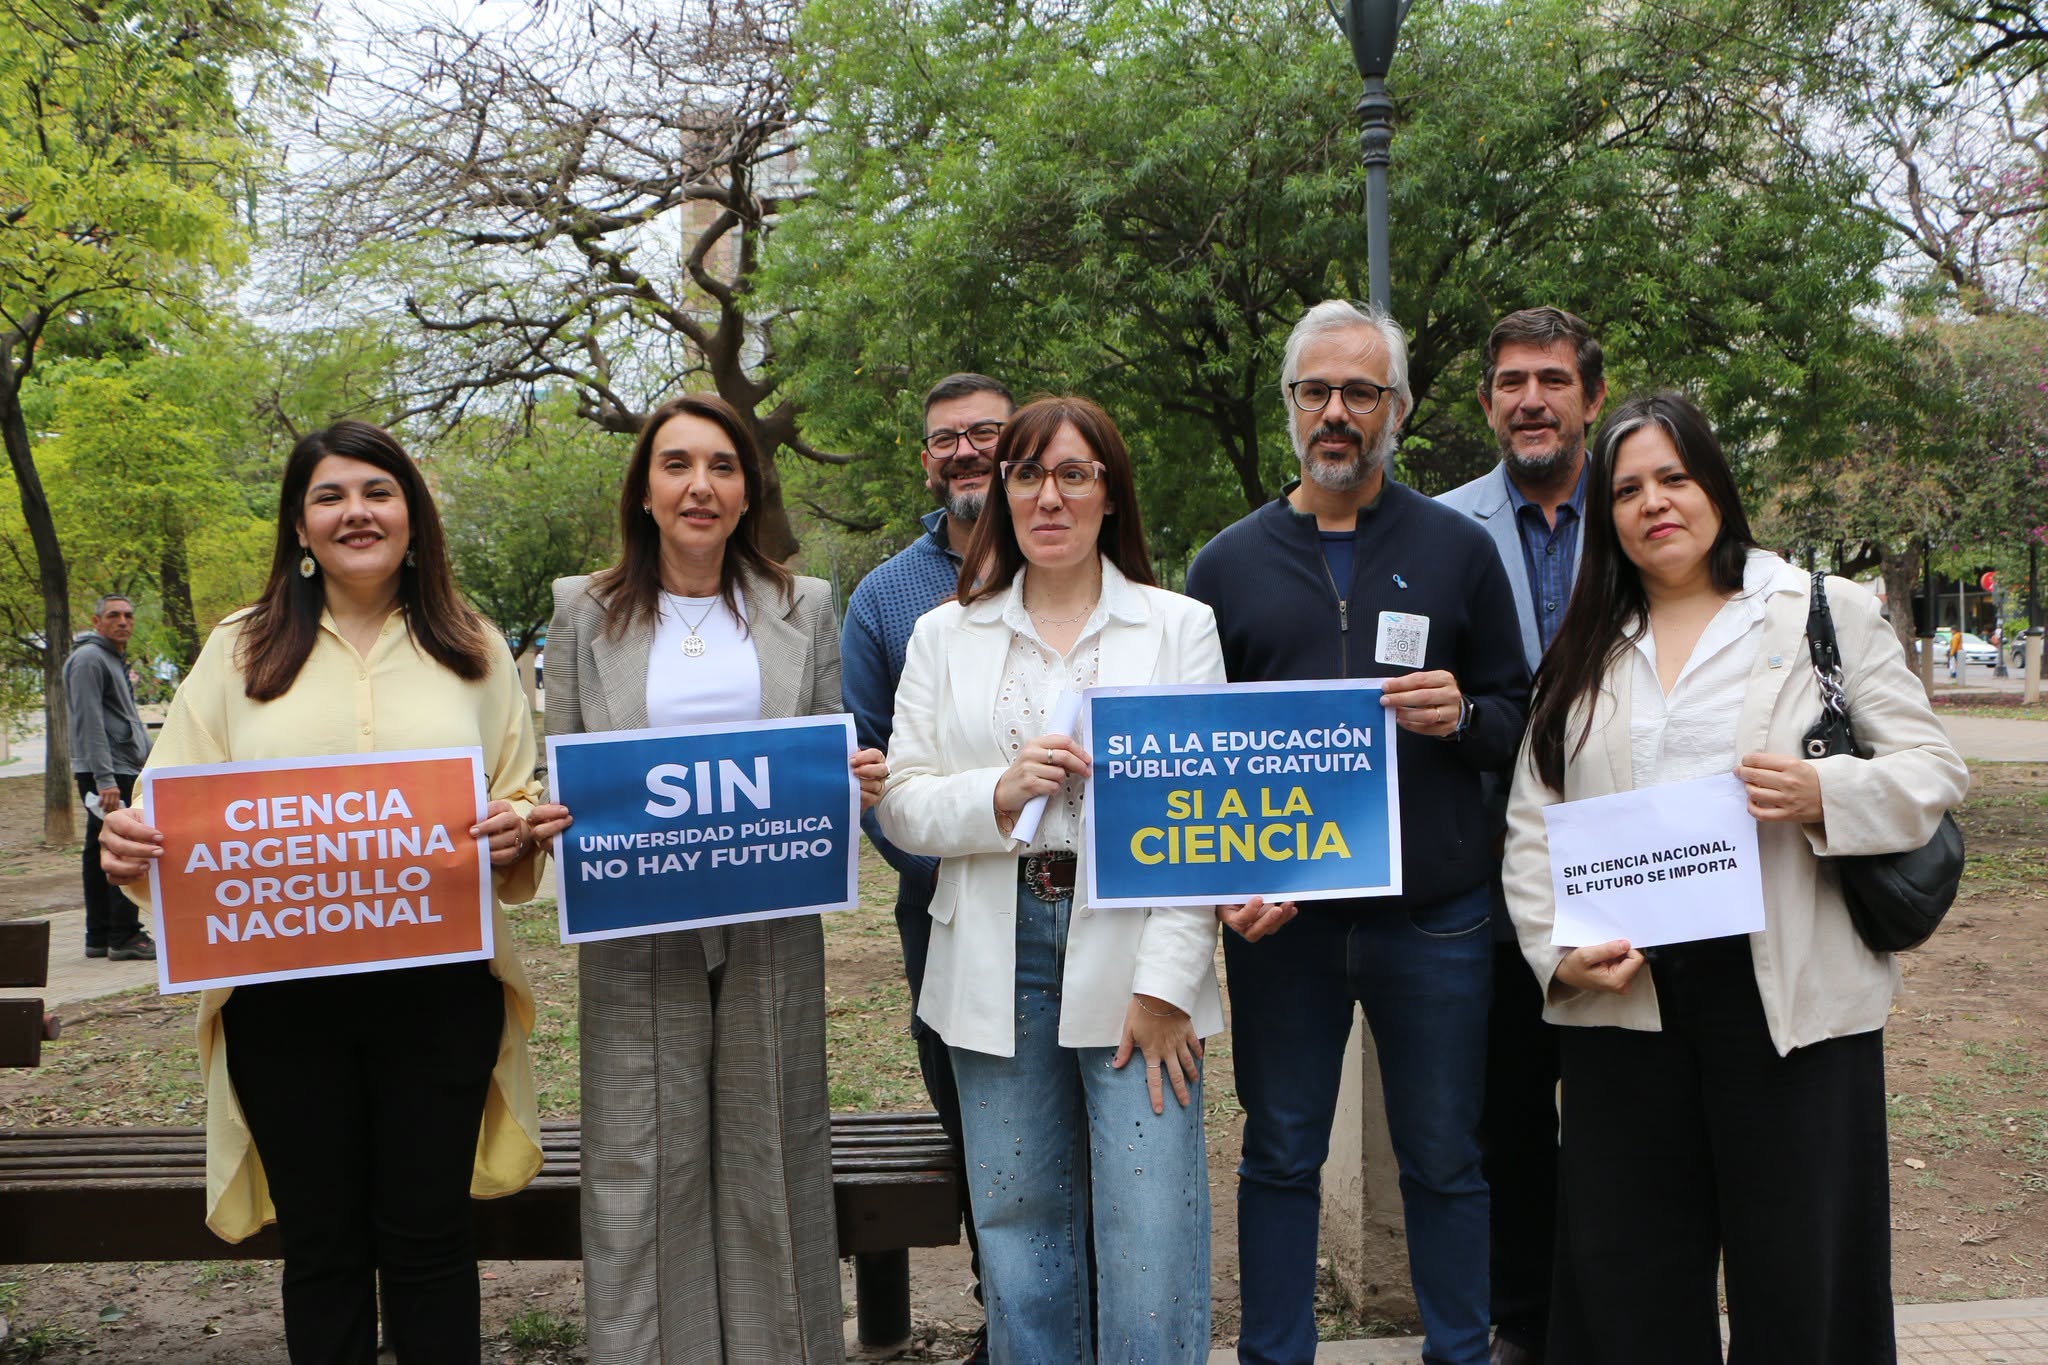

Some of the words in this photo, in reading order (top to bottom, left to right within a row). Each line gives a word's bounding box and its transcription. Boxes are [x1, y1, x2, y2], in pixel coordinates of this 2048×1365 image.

[1107, 735, 1133, 755] SI
[1140, 734, 1161, 754] A
[1169, 732, 1203, 753] LA
[1212, 723, 1372, 753] EDUCACIÓN
[1108, 755, 1217, 779] PÚBLICA
[1224, 757, 1241, 775] Y
[1247, 753, 1372, 774] GRATUITA
[645, 756, 771, 818] SIN
[1166, 789, 1203, 820] SI
[1216, 788, 1248, 818] A
[1261, 786, 1313, 817] LA
[224, 788, 412, 832] CIENCIA
[184, 825, 455, 873] ARGENTINA
[579, 825, 734, 852] UNIVERSIDAD
[741, 815, 833, 838] PÚBLICA
[1130, 821, 1351, 865] CIENCIA
[581, 859, 628, 882] NO
[638, 851, 702, 876] HAY
[712, 838, 832, 868] FUTURO
[1563, 865, 1587, 878] SIN
[1591, 854, 1649, 874] CIENCIA
[1652, 840, 1736, 864] NACIONAL,
[1567, 884, 1583, 895] EL
[1586, 873, 1644, 892] FUTURO
[1647, 870, 1665, 882] SE
[1669, 858, 1737, 879] IMPORTA
[215, 866, 431, 907] ORGULLO
[206, 896, 442, 944] NACIONAL
